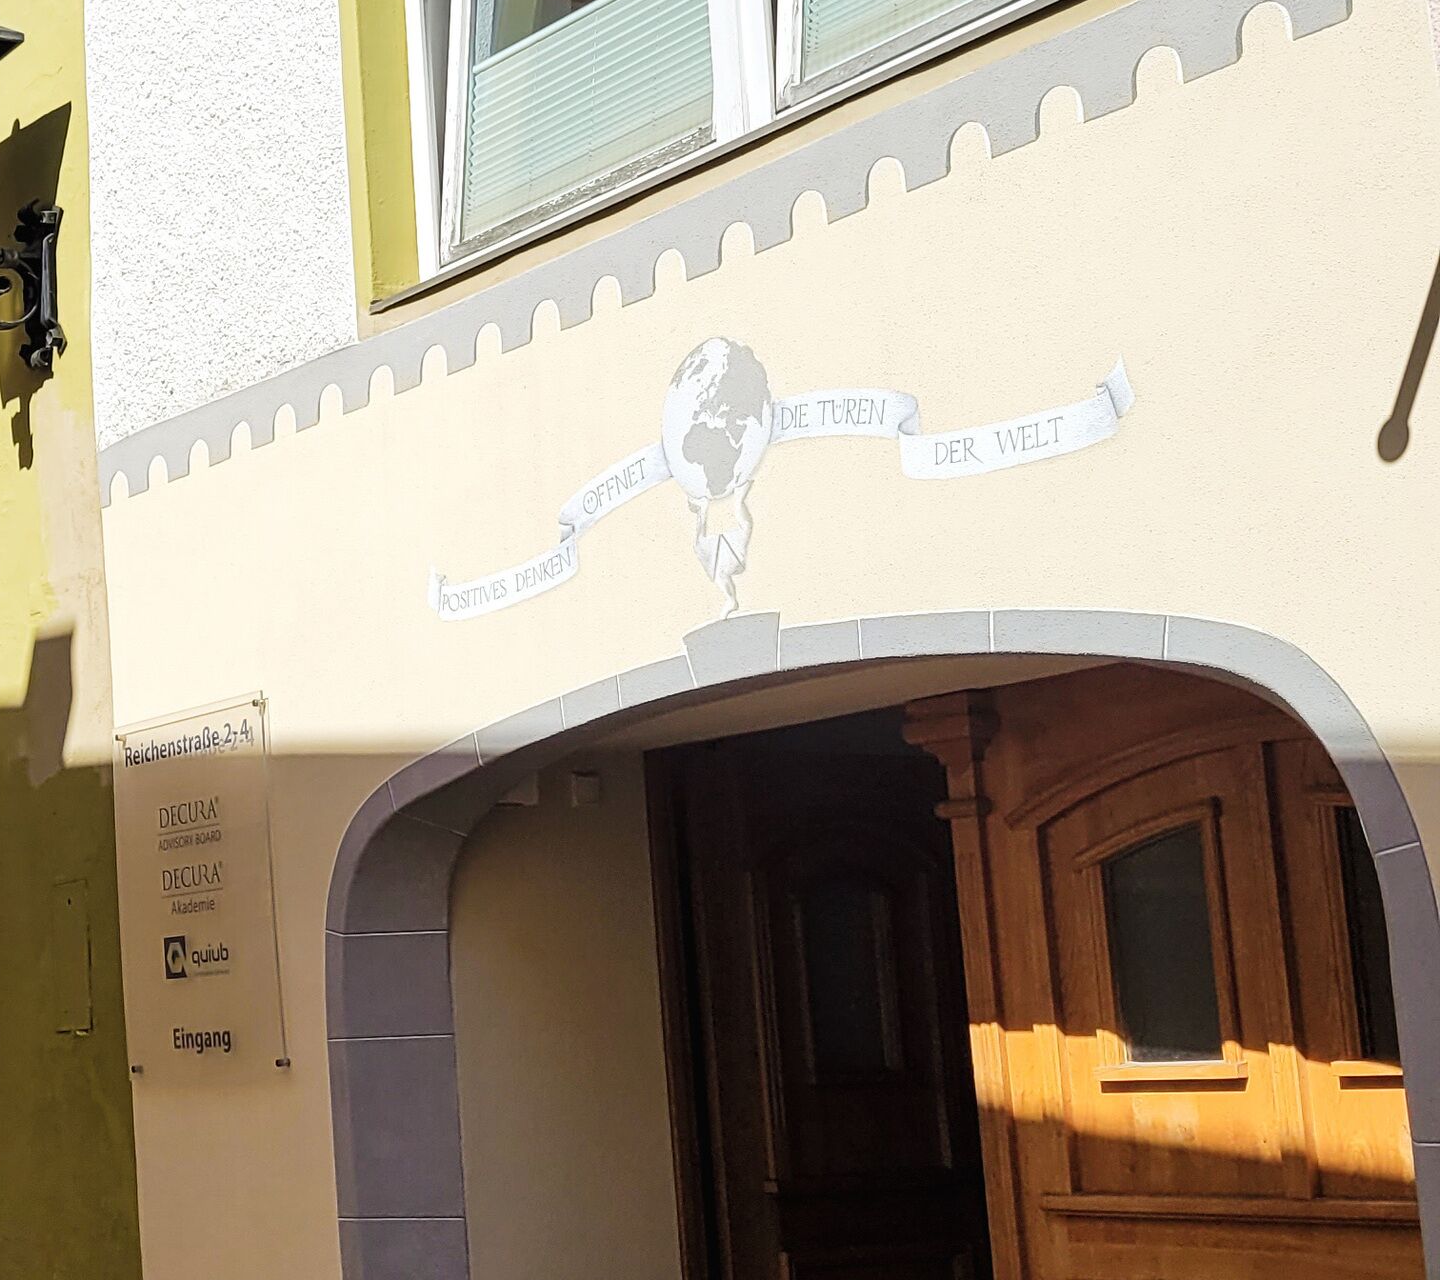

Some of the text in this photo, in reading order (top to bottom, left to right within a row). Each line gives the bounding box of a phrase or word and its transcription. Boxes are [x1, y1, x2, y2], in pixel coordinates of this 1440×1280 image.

[442, 397, 1065, 612] POSITIVES DENKEN ÖFFNET DIE TÜREN DER WELT
[124, 725, 220, 768] Reichenstraße
[171, 898, 216, 916] Akademie
[191, 942, 229, 967] quiub
[172, 1027, 231, 1054] Eingang
